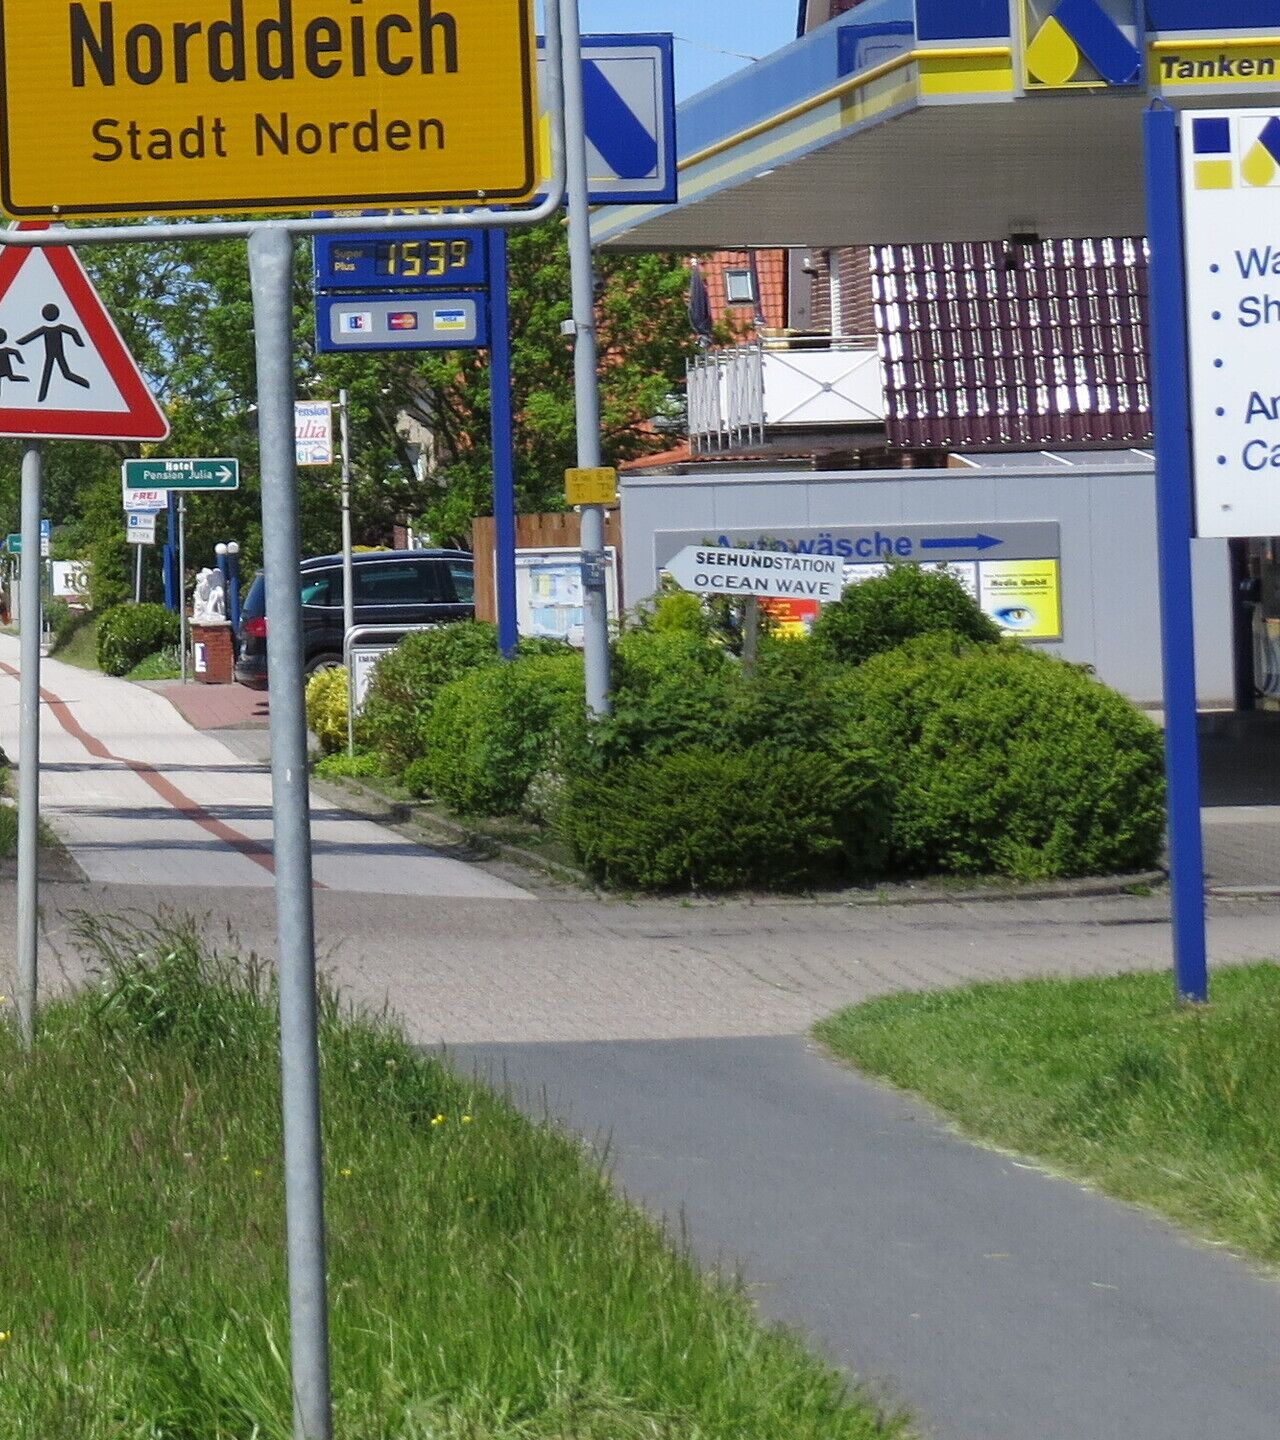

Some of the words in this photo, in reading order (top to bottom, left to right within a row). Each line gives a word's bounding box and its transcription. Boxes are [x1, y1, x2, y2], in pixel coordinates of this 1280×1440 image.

[1161, 55, 1275, 78] Tanken
[91, 116, 228, 163] Stadt
[255, 110, 446, 157] Norden
[334, 261, 356, 272] Plus
[1238, 293, 1280, 327] Sh
[143, 470, 184, 480] Pension
[188, 470, 213, 480] Julia
[165, 461, 194, 471] Hotel
[132, 491, 158, 501] FREI
[695, 551, 835, 574] SEEHUNDSTATION
[693, 573, 769, 591] OCEAN
[775, 579, 830, 596] WAVE
